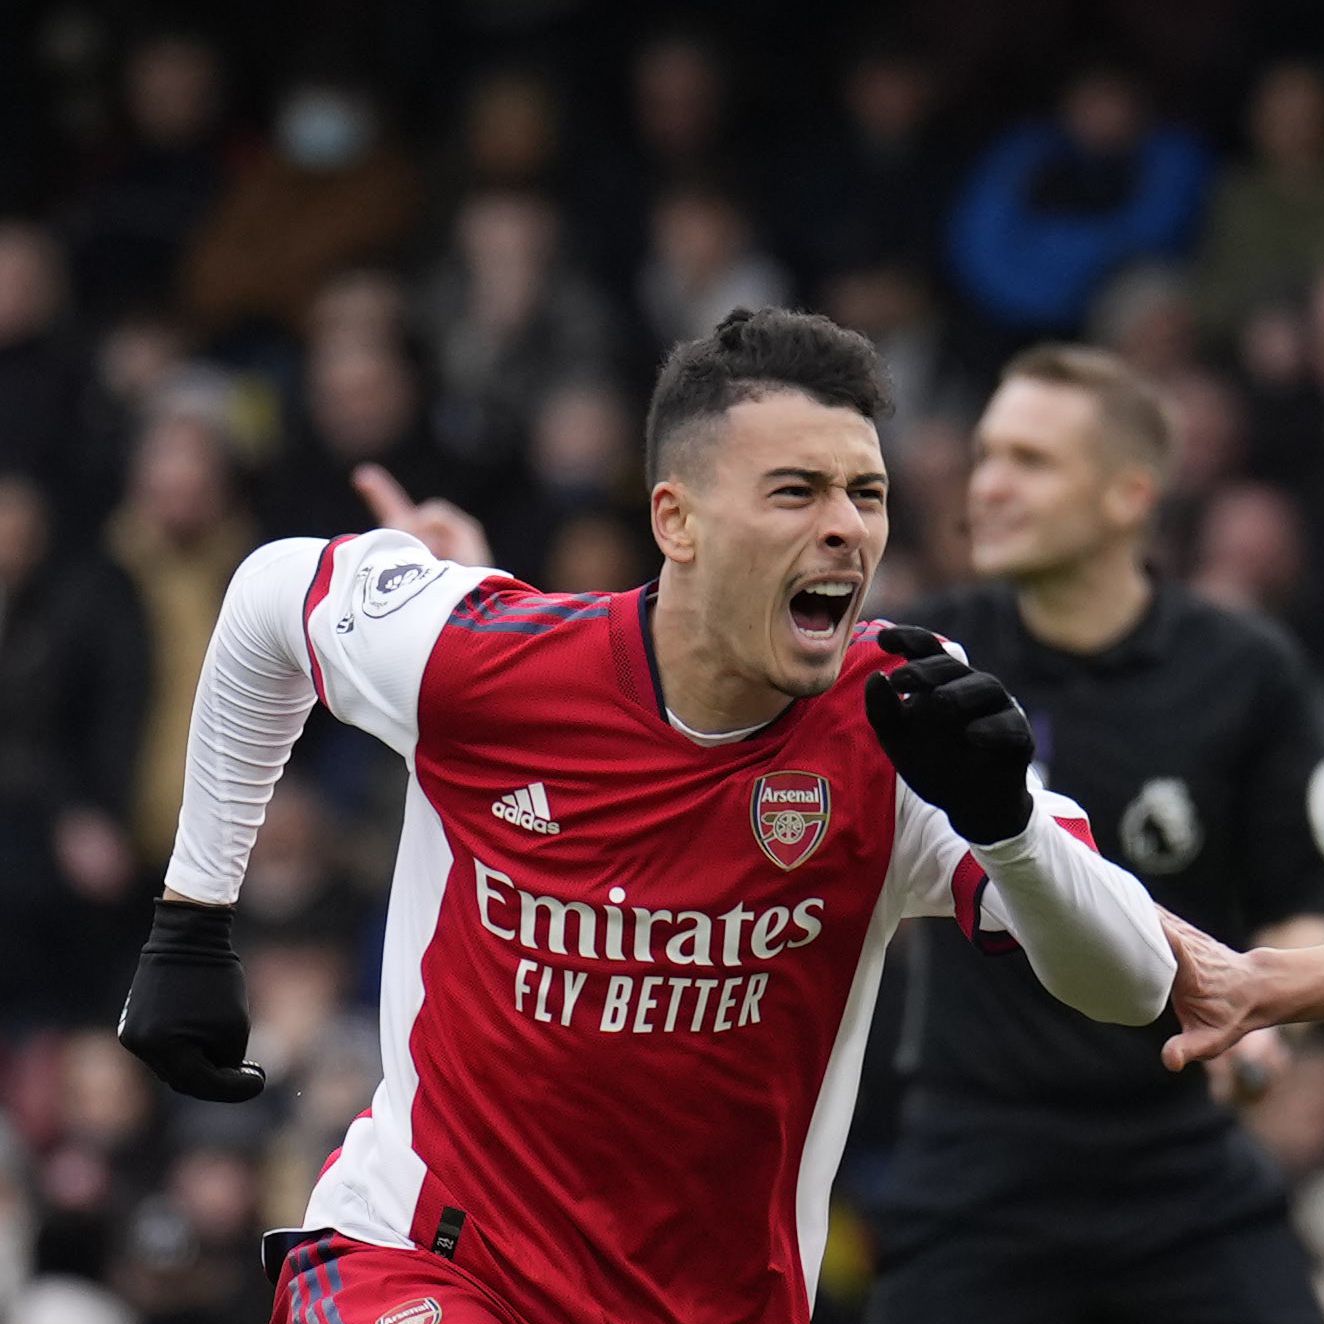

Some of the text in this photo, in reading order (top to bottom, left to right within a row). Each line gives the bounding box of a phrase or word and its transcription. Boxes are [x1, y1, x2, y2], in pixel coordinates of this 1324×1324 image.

[491, 800, 560, 835] adidas
[761, 786, 820, 803] Arsenal
[473, 857, 825, 967] Emirates
[514, 958, 769, 1034] FLY BETTER
